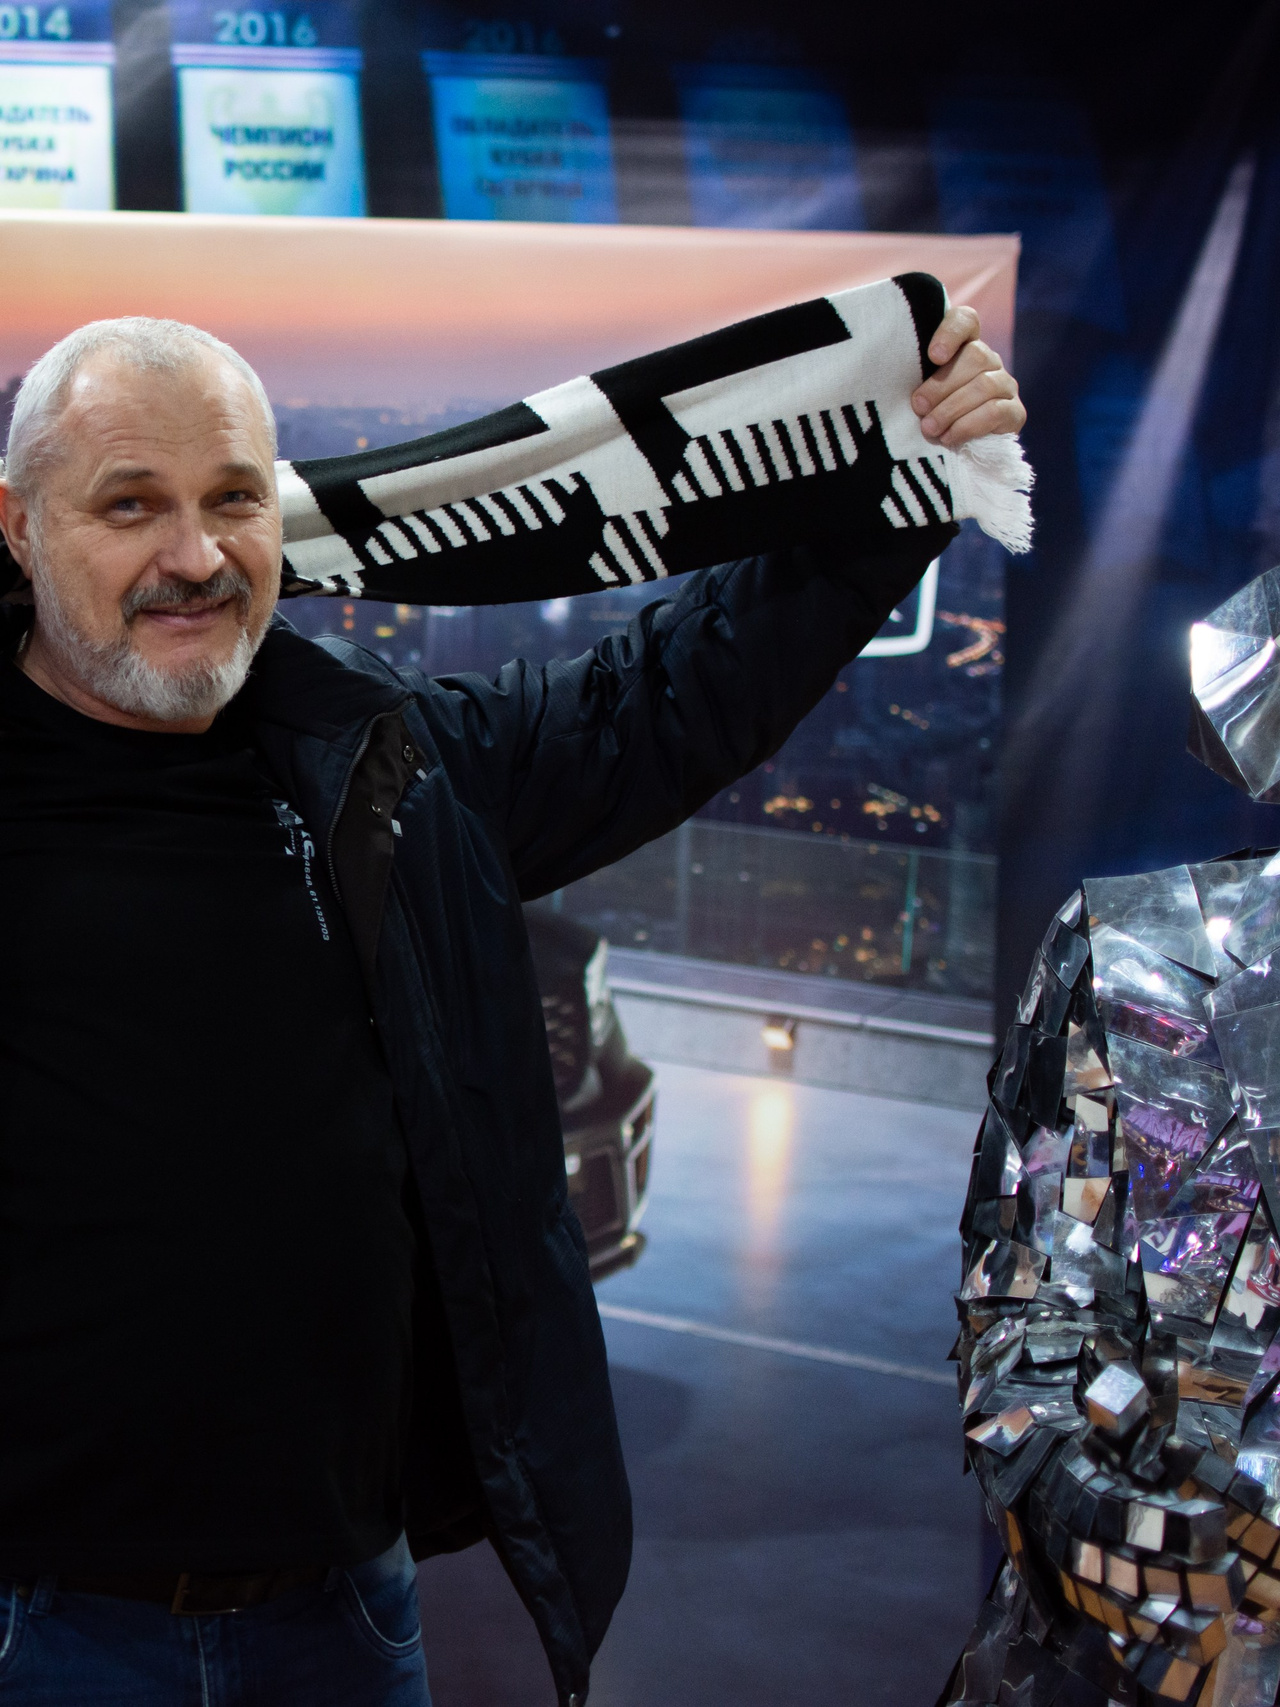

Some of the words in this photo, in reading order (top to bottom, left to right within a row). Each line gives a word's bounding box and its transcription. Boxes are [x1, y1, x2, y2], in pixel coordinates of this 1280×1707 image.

[214, 10, 318, 46] 2016
[210, 125, 334, 147] ЧЕМПИОН
[225, 159, 326, 181] РОССИИ
